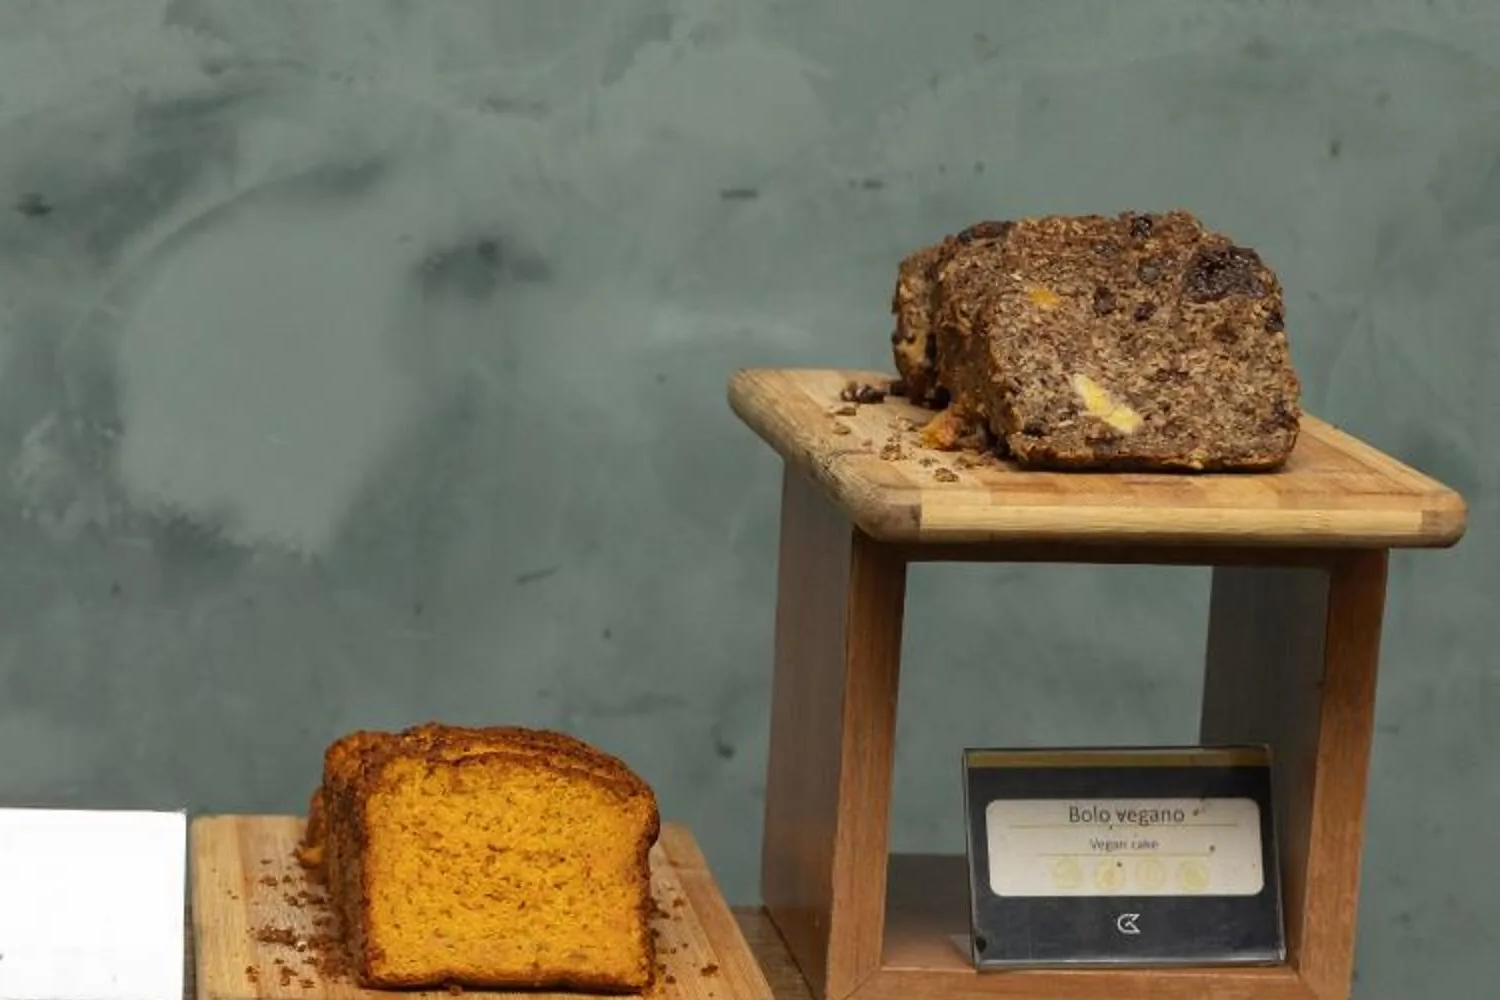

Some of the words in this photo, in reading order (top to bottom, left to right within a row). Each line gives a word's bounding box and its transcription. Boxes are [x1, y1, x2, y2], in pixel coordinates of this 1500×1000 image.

[1068, 805, 1111, 824] Bolo
[1116, 808, 1185, 826] vegano
[1089, 837, 1127, 852] Vegan
